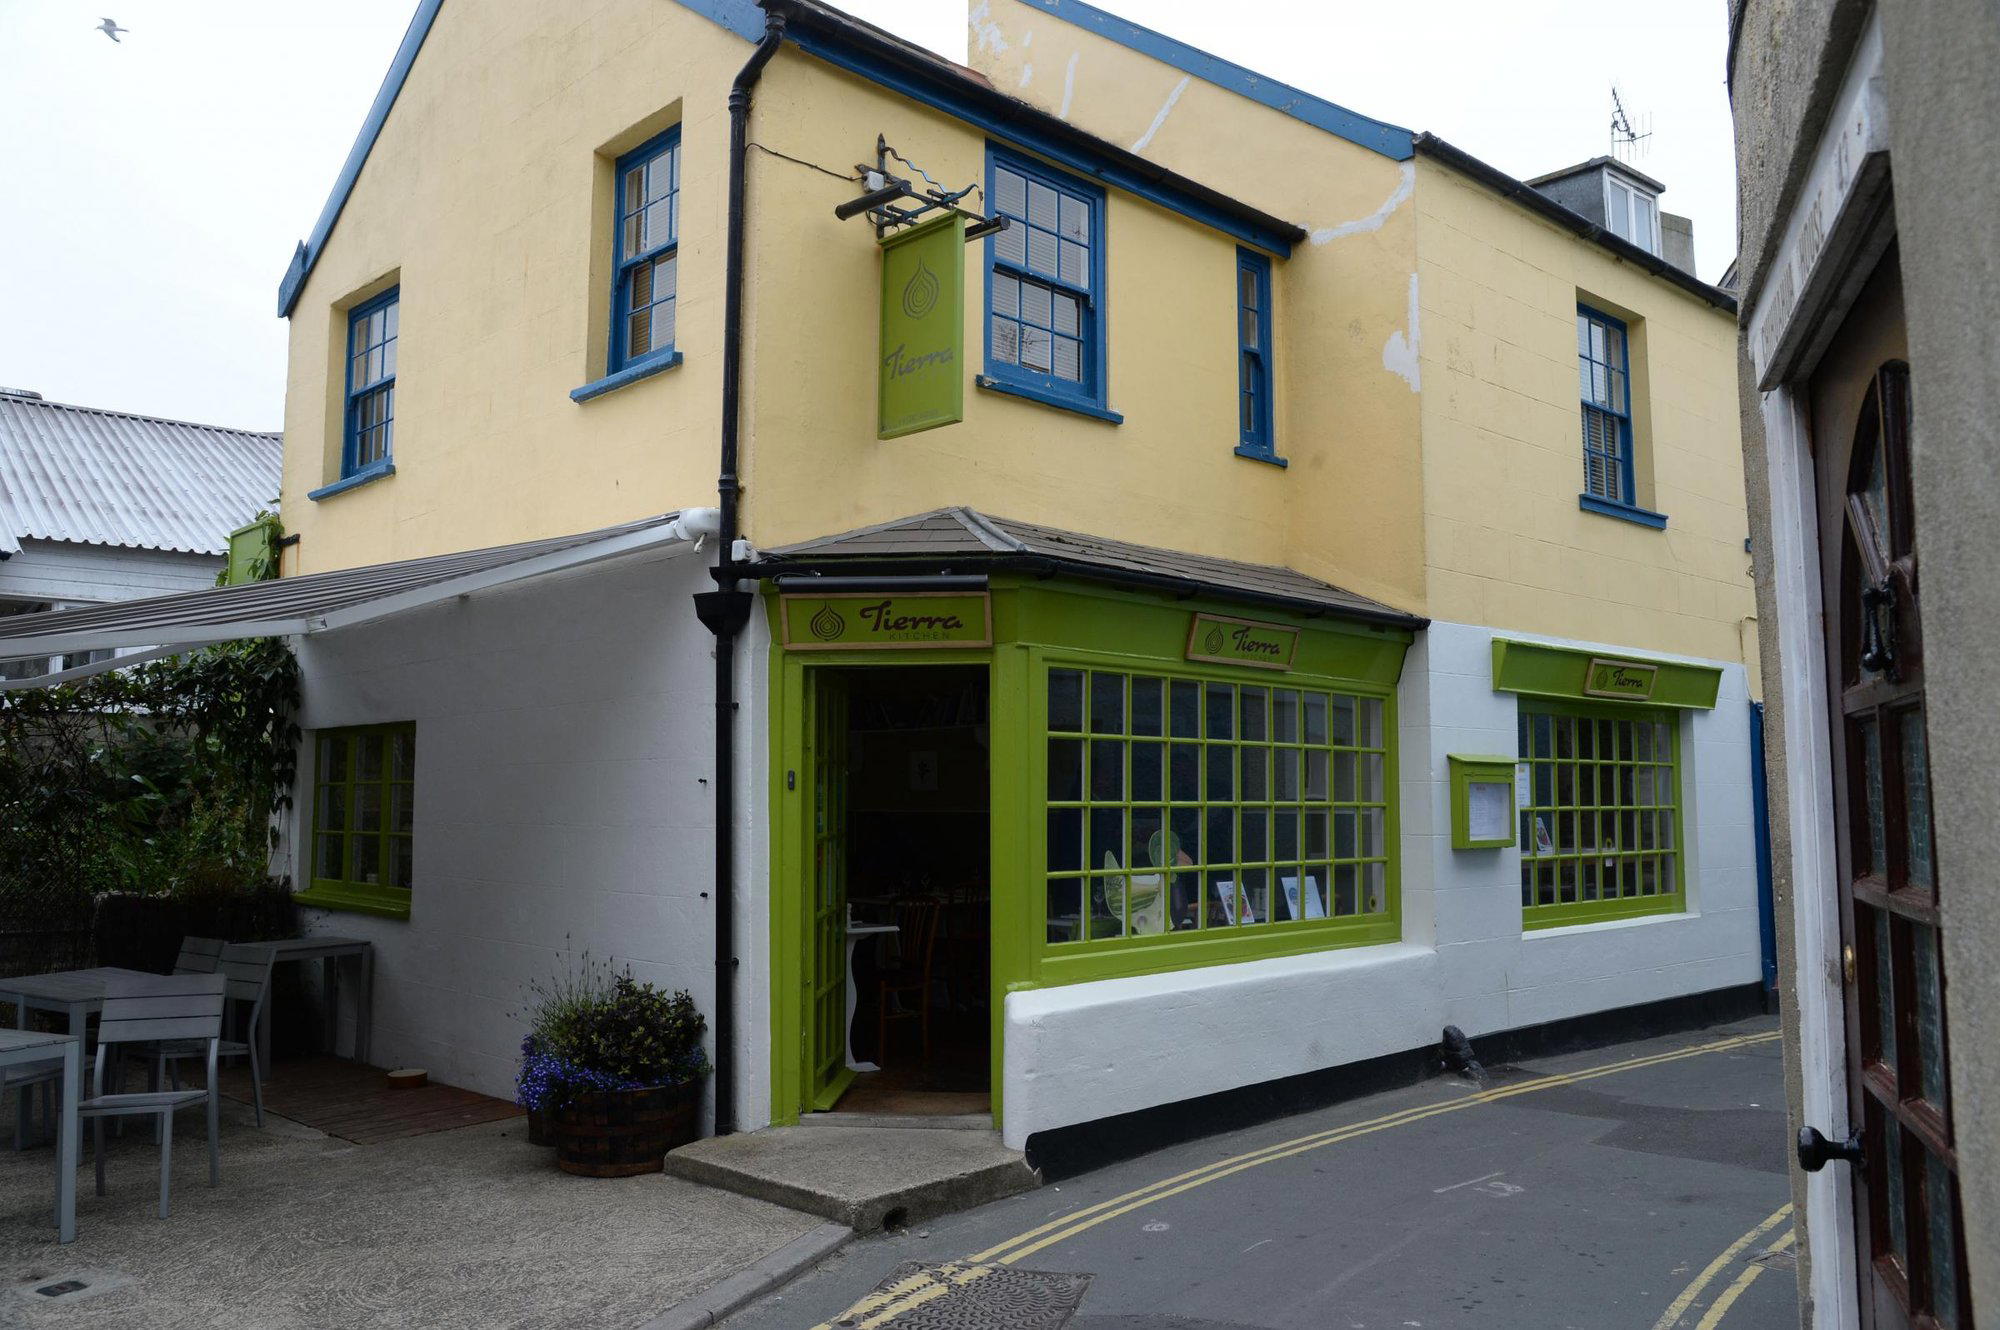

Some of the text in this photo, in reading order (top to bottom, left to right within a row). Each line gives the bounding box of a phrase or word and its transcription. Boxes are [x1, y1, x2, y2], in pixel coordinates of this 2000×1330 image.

[883, 343, 954, 380] Tierra
[860, 600, 963, 632] Tierra
[889, 632, 949, 640] KITCHEN
[1232, 626, 1281, 655] Tierra
[1613, 667, 1643, 688] Tierra
